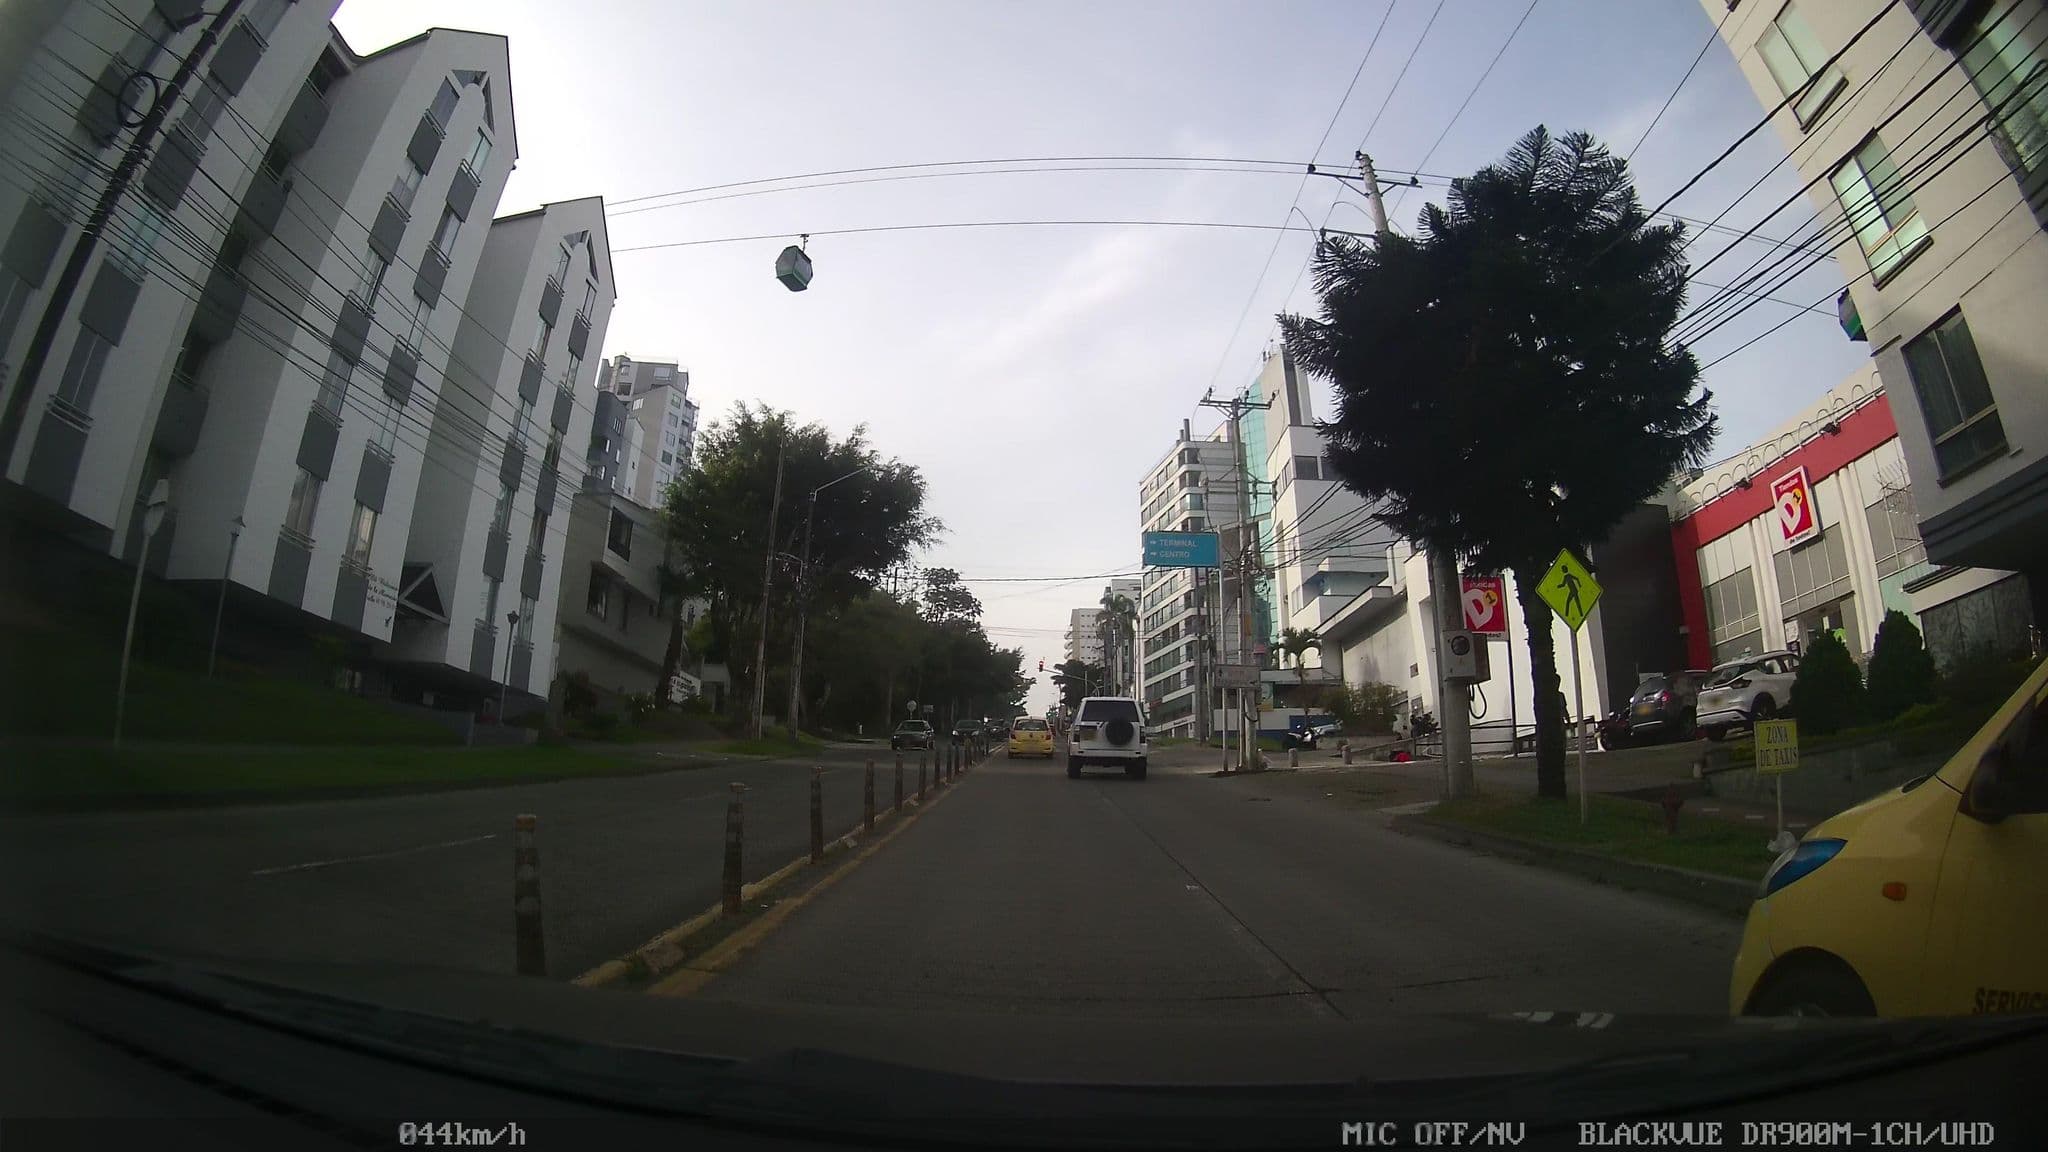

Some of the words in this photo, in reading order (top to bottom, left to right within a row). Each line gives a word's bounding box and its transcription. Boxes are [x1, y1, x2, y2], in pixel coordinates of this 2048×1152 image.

[1159, 539, 1198, 548] TERMINAL
[1766, 725, 1789, 745] ZONA
[1760, 748, 1772, 767] DE
[1774, 746, 1798, 766] TAXIS
